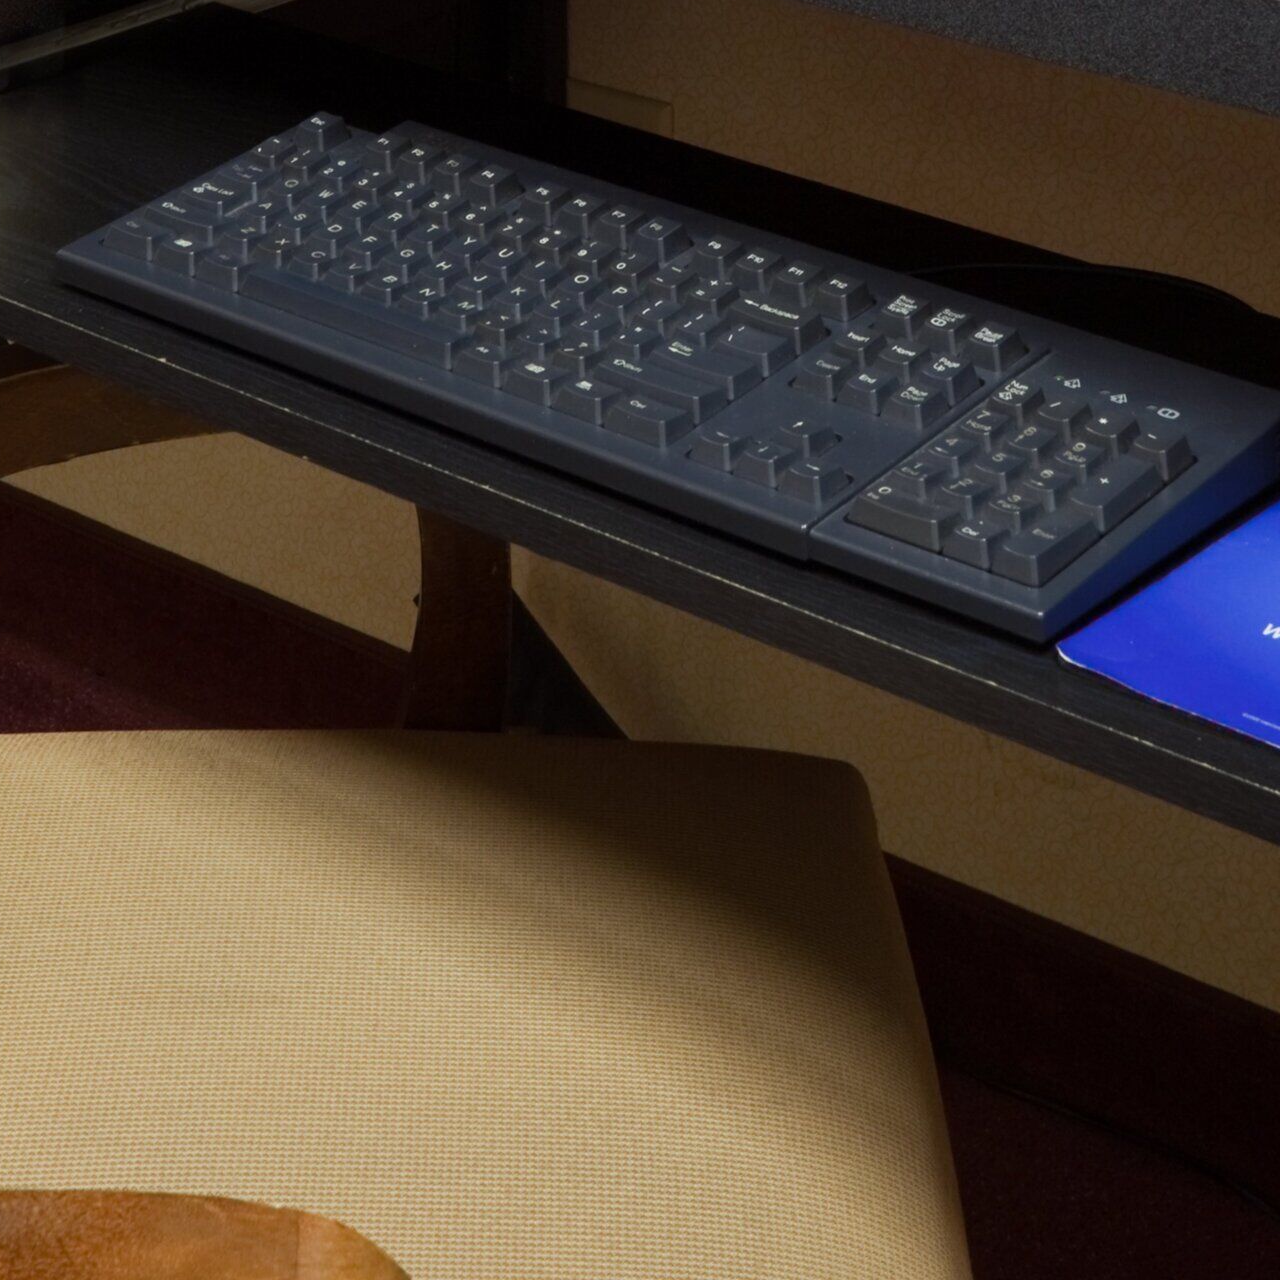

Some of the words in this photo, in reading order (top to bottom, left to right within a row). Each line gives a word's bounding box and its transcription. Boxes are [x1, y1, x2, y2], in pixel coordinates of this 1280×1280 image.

[318, 189, 335, 199] W
[351, 200, 368, 210] E
[387, 211, 404, 222] R
[426, 223, 441, 233] T
[463, 236, 478, 247] Y
[498, 249, 514, 259] U
[574, 274, 590, 285] O
[612, 286, 629, 296] P
[259, 201, 273, 210] A
[293, 212, 307, 222] S
[327, 224, 343, 233] D
[362, 235, 379, 245] F
[399, 248, 416, 259] G
[435, 261, 453, 271] H
[473, 274, 489, 283] J
[510, 286, 527, 296] K
[550, 299, 561, 310] L
[382, 274, 399, 284] B
[419, 287, 436, 298] N
[759, 303, 801, 321] Backspace
[891, 345, 917, 357] Home
